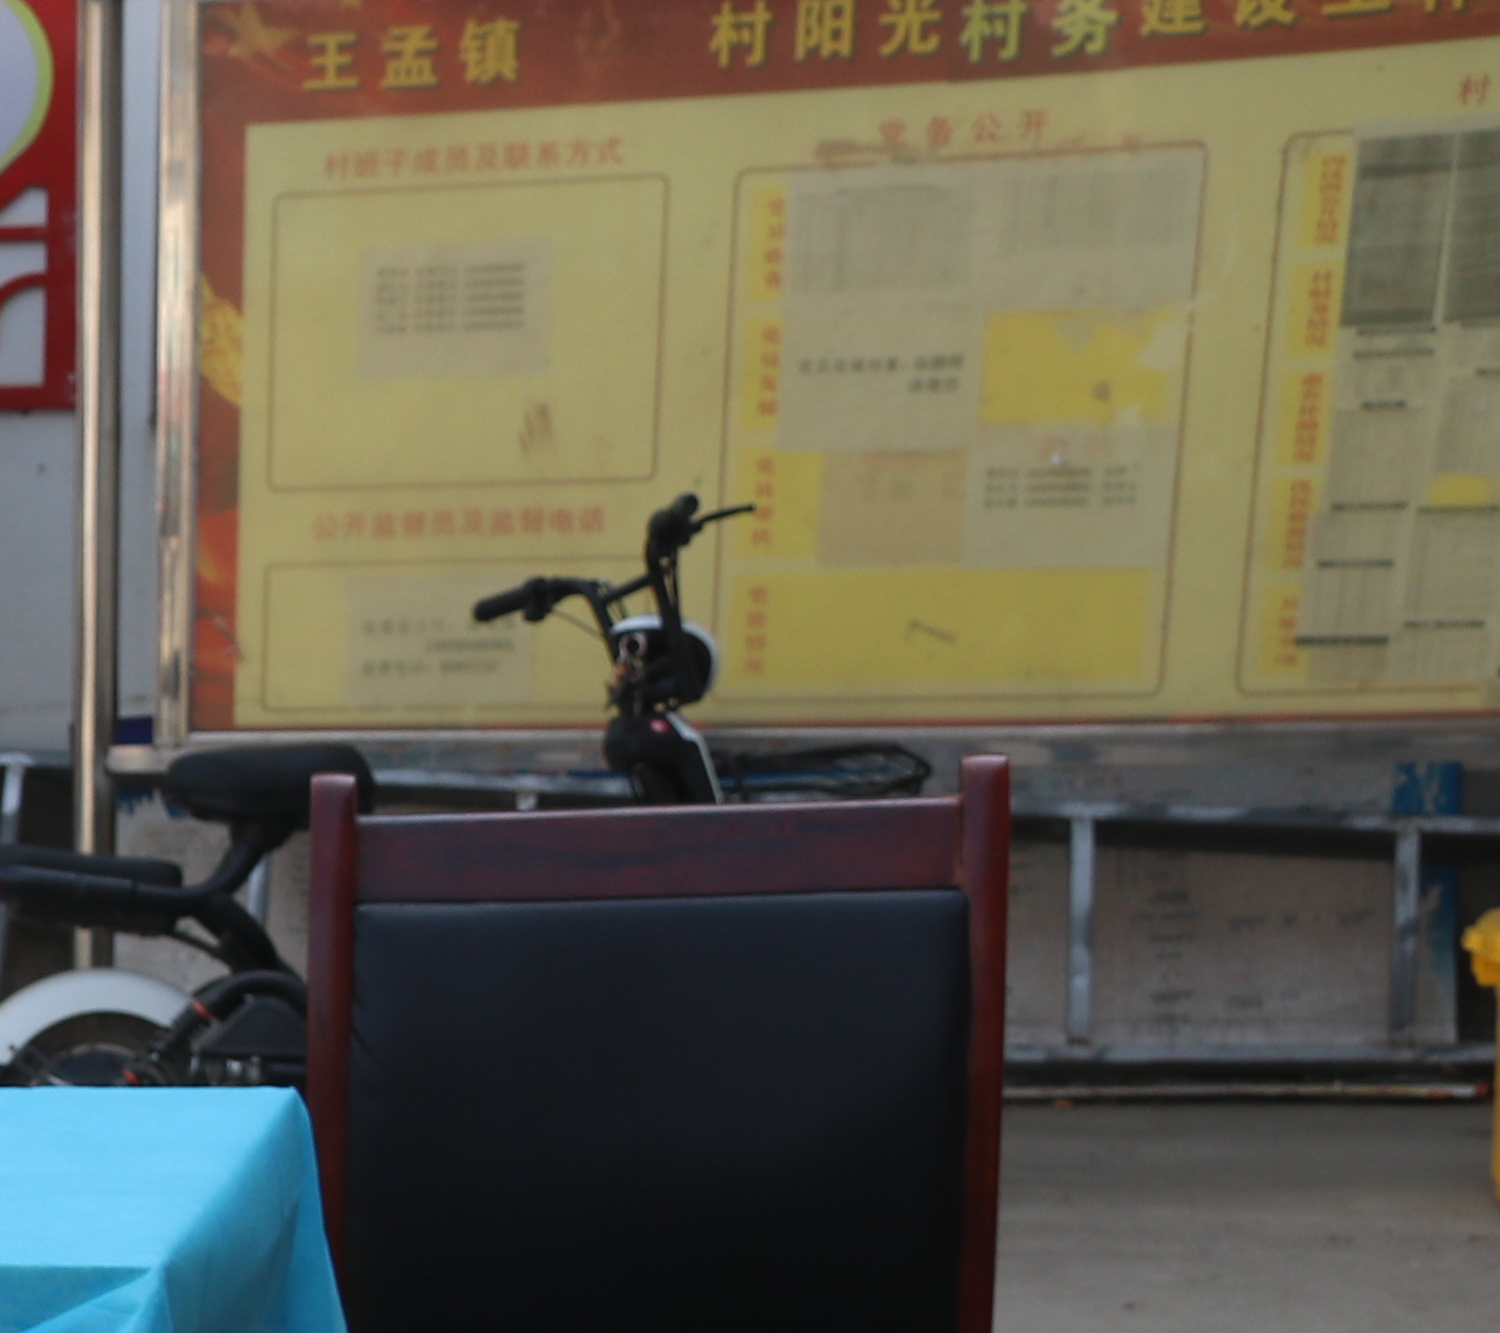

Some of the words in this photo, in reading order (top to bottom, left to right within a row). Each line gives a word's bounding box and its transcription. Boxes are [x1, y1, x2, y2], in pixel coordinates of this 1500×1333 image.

[302, 16, 521, 91] 王孟镇
[708, 0, 1474, 68] 村阳光村务建
